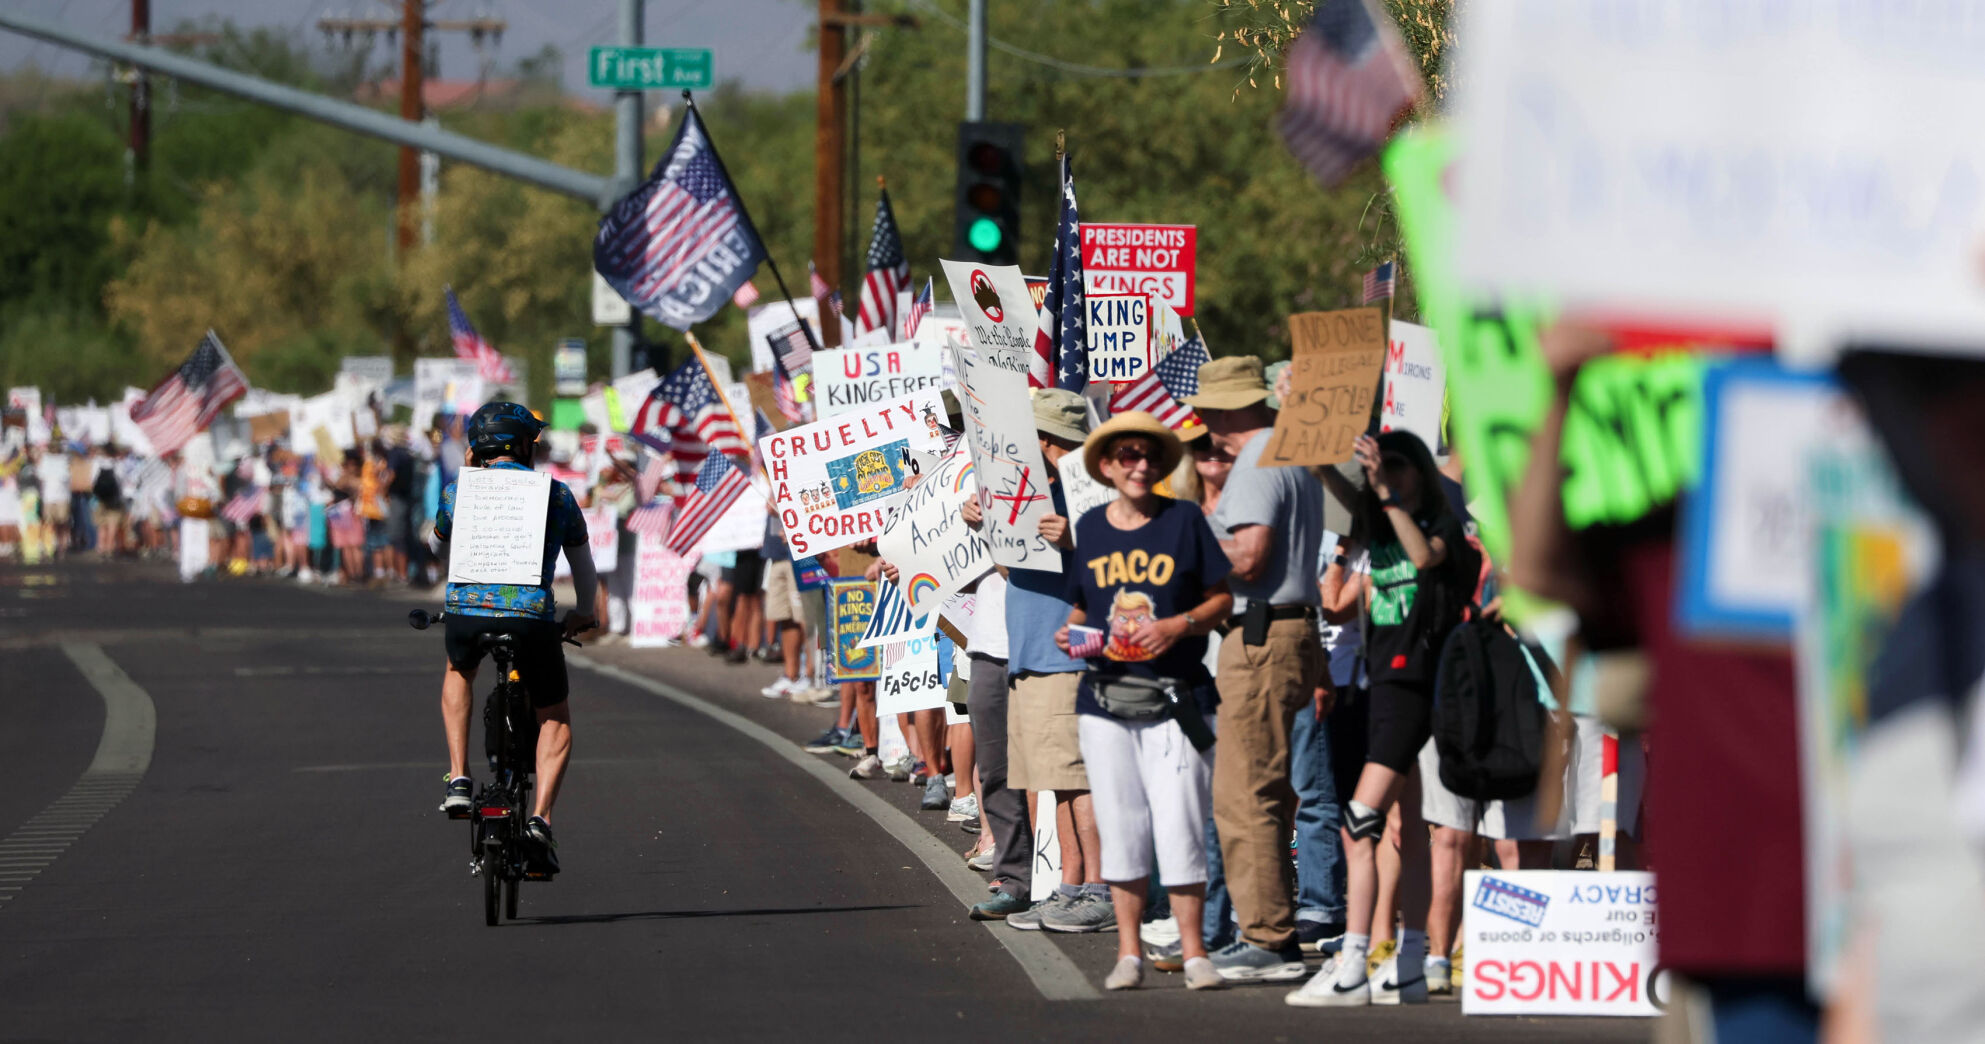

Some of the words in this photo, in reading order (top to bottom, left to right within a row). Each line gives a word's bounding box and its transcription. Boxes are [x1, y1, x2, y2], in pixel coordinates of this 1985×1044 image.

[598, 49, 664, 84] First
[1085, 229, 1186, 247] PRESIDENTS
[1090, 247, 1130, 267] ARE
[1136, 250, 1180, 268] NOT
[1029, 287, 1046, 306] NO
[1091, 300, 1144, 326] KING
[1334, 314, 1379, 347] ONE
[843, 351, 901, 379] USA
[770, 400, 917, 459] CRUELTY
[1274, 425, 1355, 461] LAND
[901, 447, 920, 476] NO
[1087, 549, 1175, 589] TACO
[846, 590, 865, 602] NO
[840, 602, 873, 617] KINGS
[1606, 910, 1638, 922] our
[1478, 929, 1533, 944] goons
[1539, 931, 1557, 943] or
[1562, 929, 1646, 945] oligarchs
[1473, 959, 1640, 1002] KINGS
